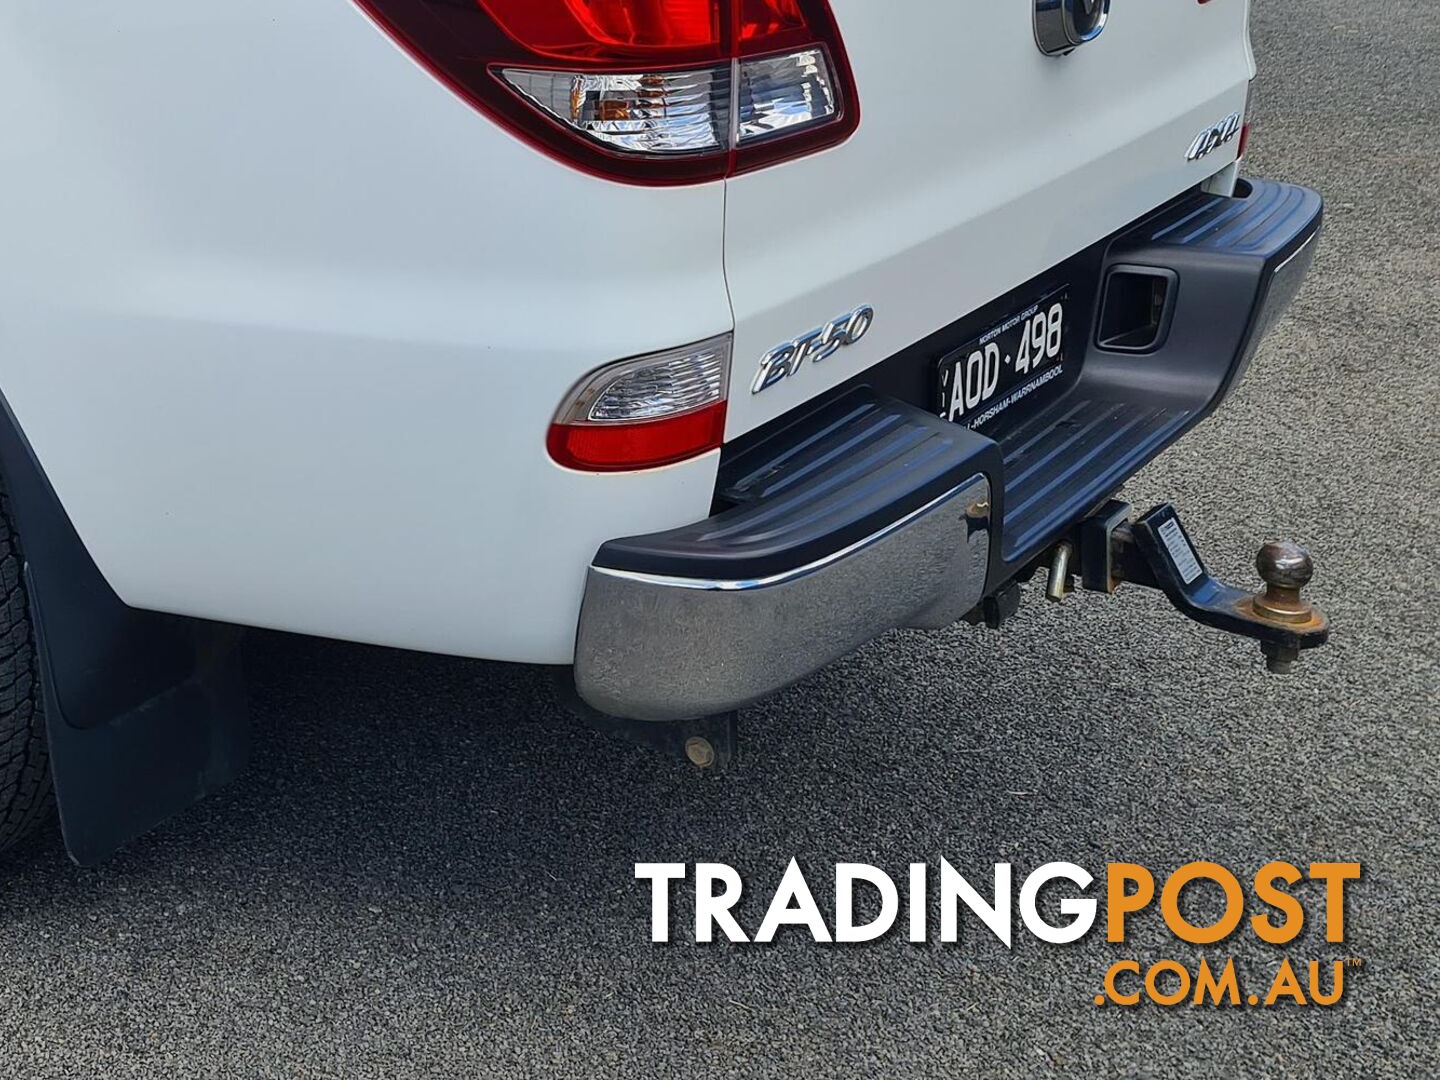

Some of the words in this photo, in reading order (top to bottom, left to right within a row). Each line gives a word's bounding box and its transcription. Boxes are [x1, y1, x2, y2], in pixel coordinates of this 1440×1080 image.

[751, 303, 874, 396] BT-50
[948, 341, 1000, 423] AOD
[1015, 302, 1064, 375] 498
